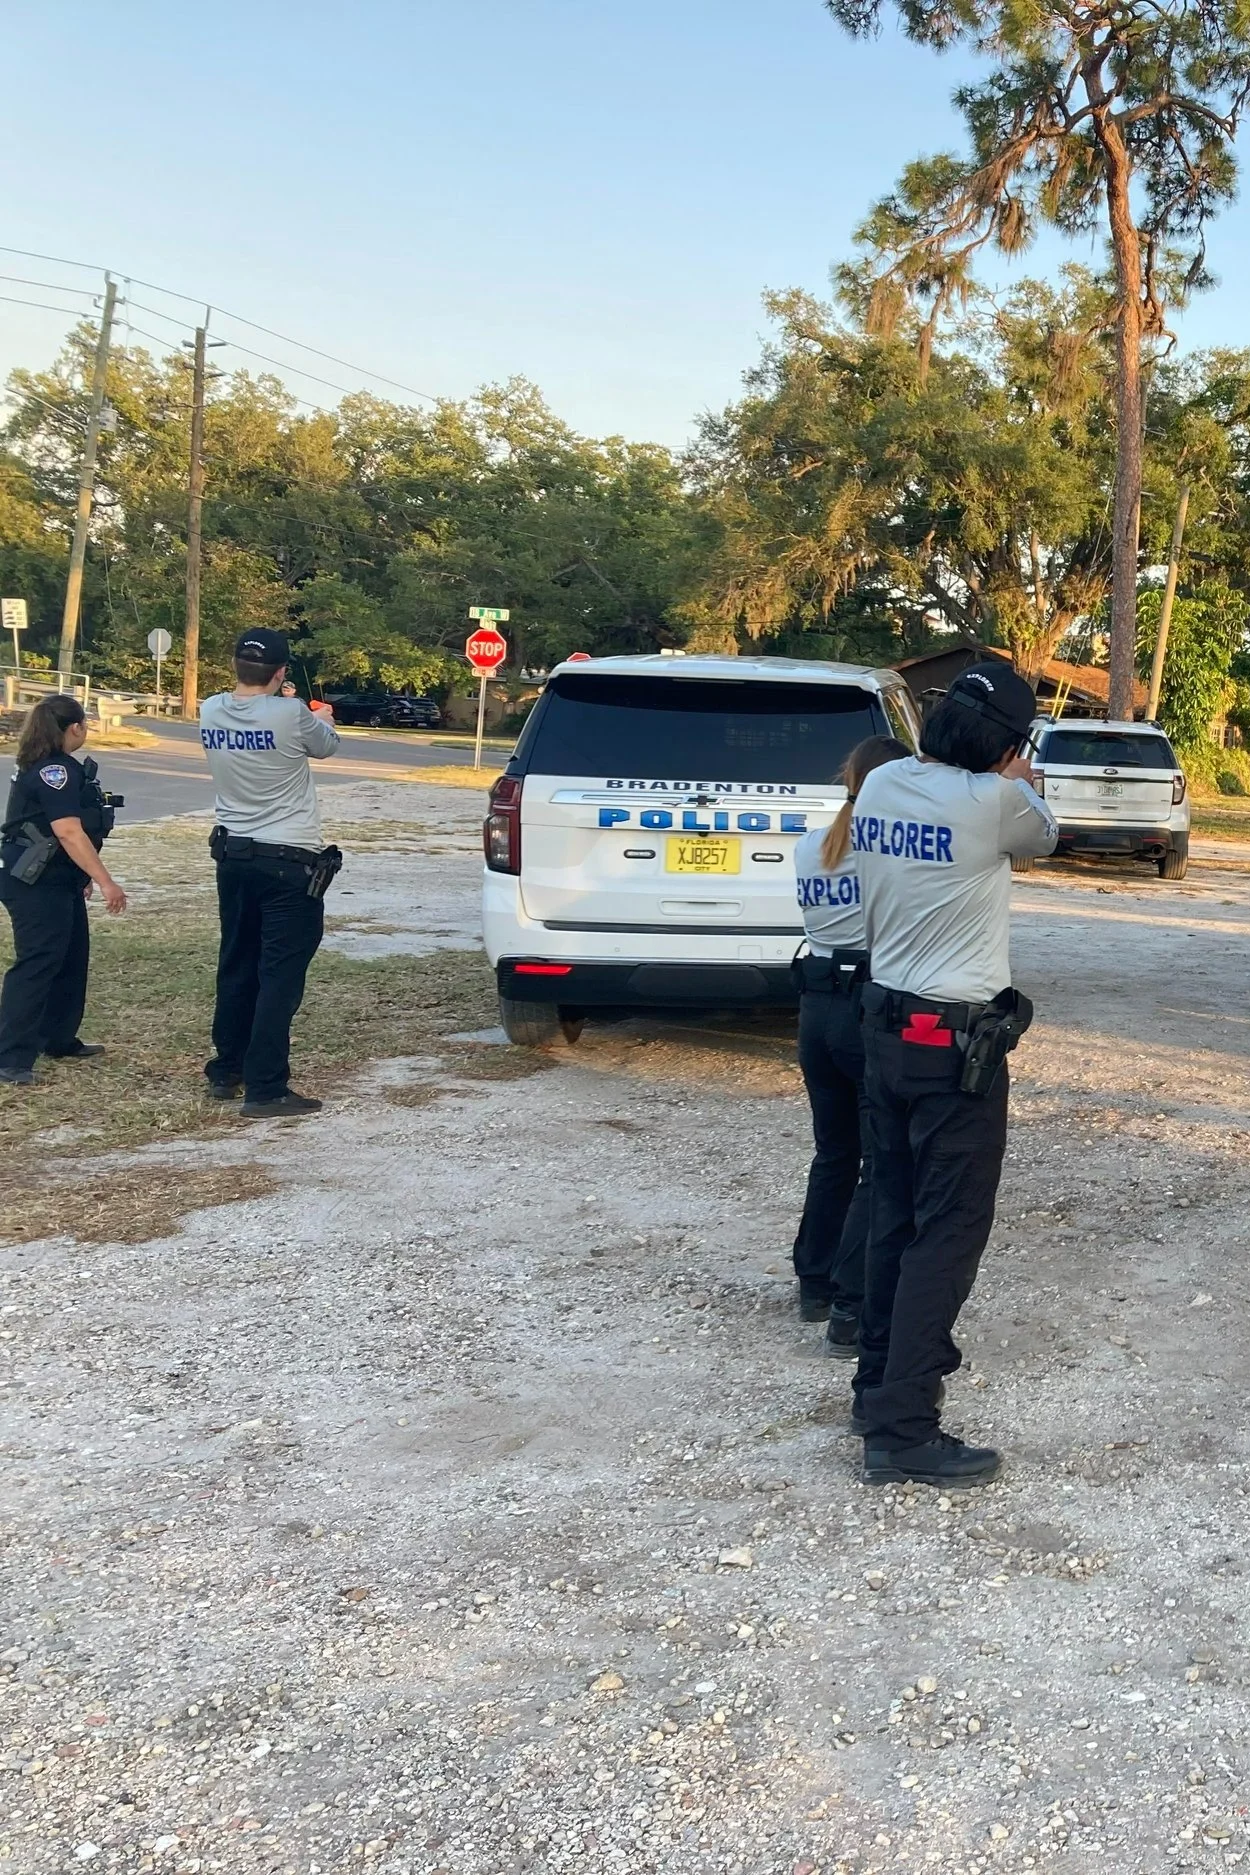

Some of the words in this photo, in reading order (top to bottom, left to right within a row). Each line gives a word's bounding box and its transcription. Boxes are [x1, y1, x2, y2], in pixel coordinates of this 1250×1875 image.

[469, 641, 503, 657] STOP
[966, 673, 995, 692] EXPLORER
[201, 729, 277, 750] EXPLORER
[606, 779, 797, 795] BRADENTON
[599, 808, 807, 832] POLICE
[678, 847, 727, 865] XJ8257
